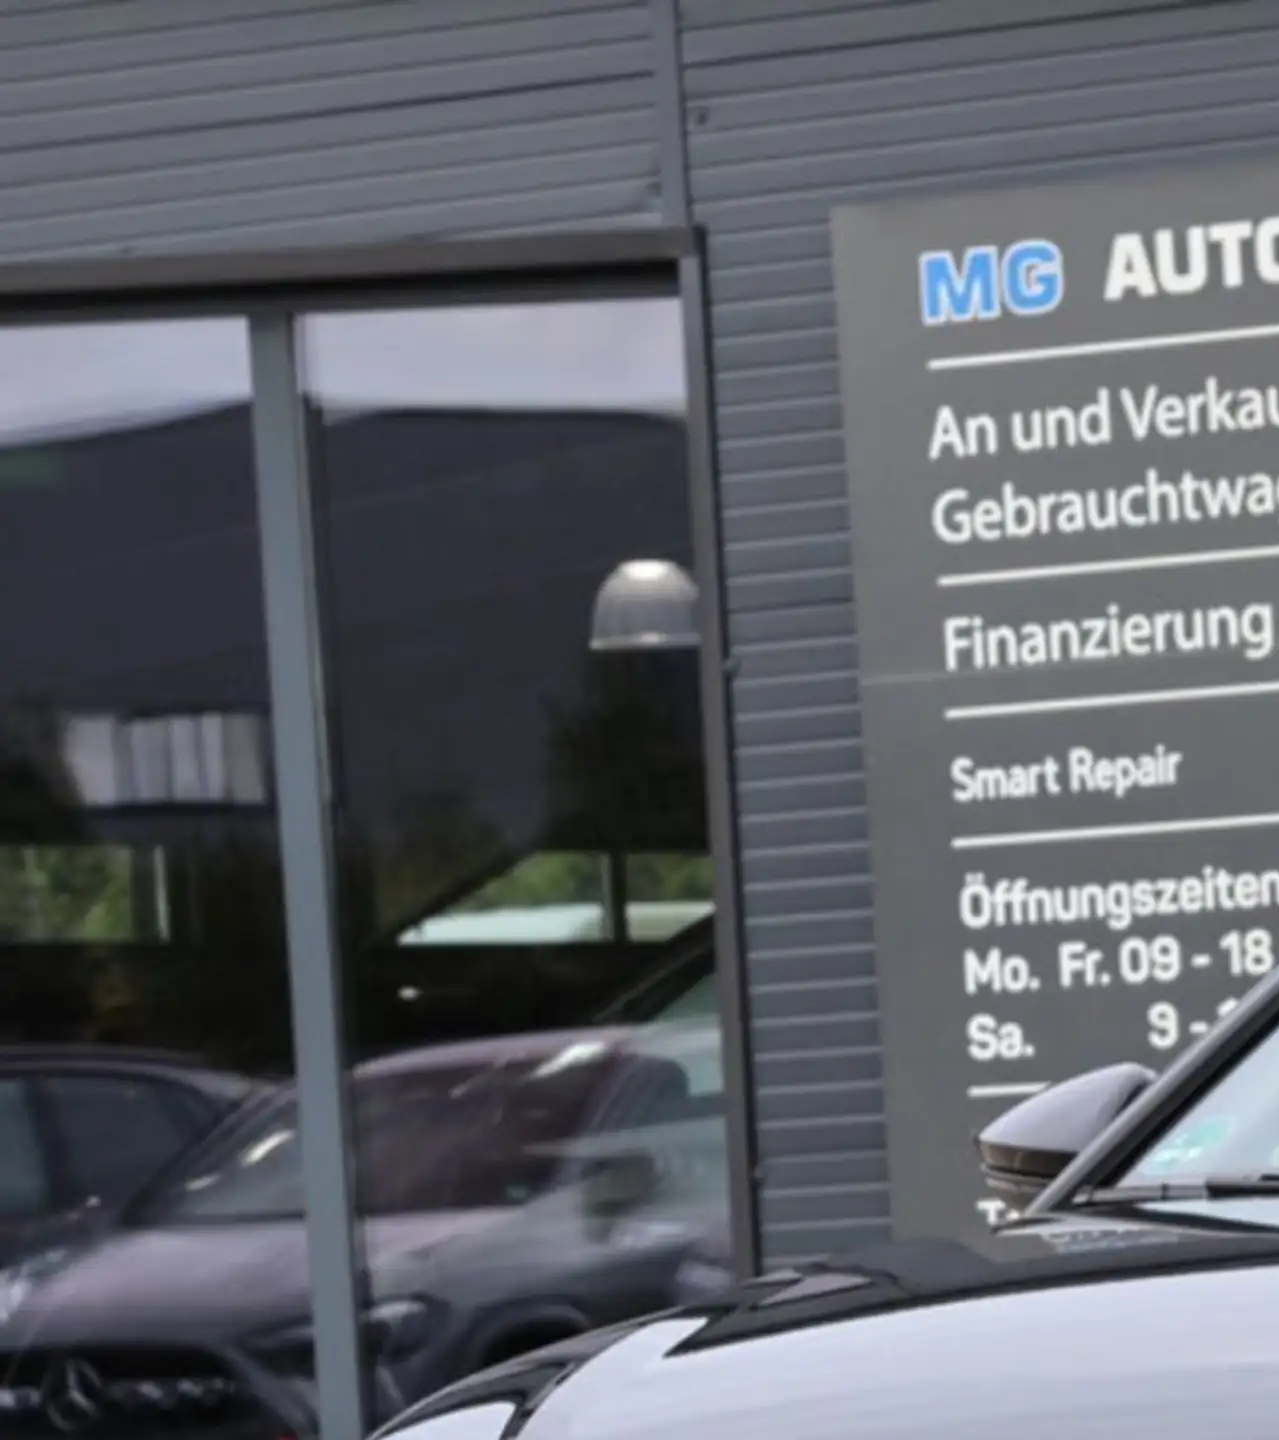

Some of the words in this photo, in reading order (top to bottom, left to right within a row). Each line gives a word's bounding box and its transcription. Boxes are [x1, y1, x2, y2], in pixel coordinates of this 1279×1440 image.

[920, 239, 1064, 325] MG
[929, 405, 998, 460] An
[1011, 389, 1112, 452] und
[944, 603, 1274, 672] Finanzierung
[950, 756, 1061, 802] Smart
[1068, 744, 1182, 798] Repair
[964, 947, 1041, 994] Mo.
[1058, 941, 1111, 988] Fr.
[1119, 935, 1181, 984] 09
[1219, 928, 1274, 976] 18
[967, 1013, 1035, 1061] Sa.
[1147, 1001, 1179, 1049] 9
